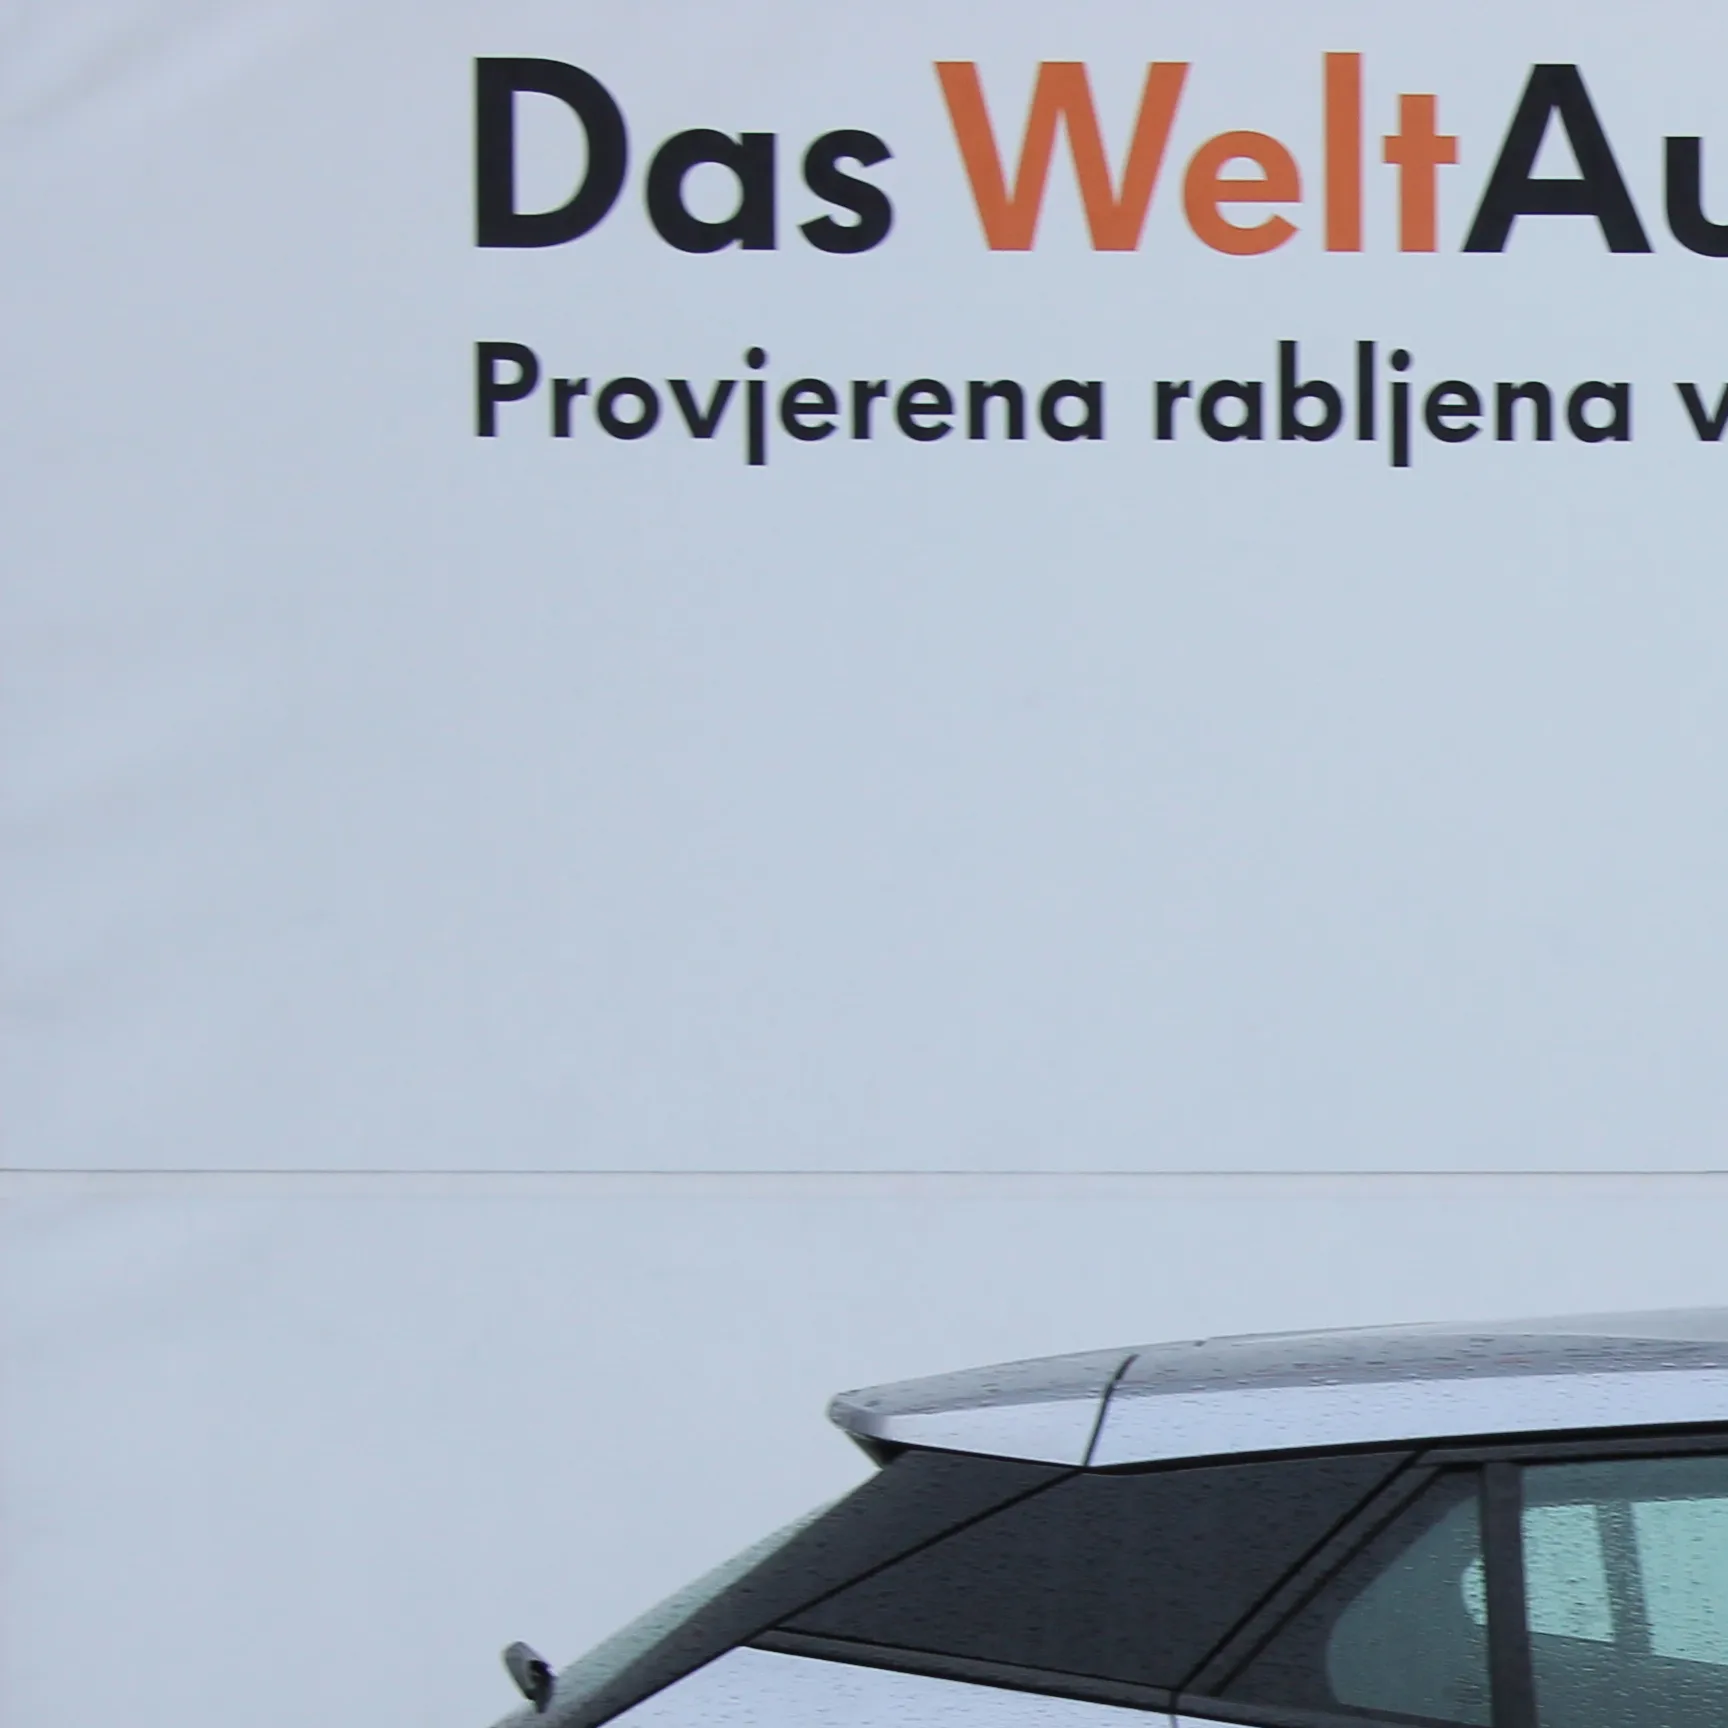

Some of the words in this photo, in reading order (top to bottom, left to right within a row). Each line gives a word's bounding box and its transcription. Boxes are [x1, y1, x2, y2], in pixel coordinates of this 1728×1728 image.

[474, 57, 893, 255] Das
[474, 340, 1104, 467] Provjerena
[1155, 339, 1631, 468] rabljena
